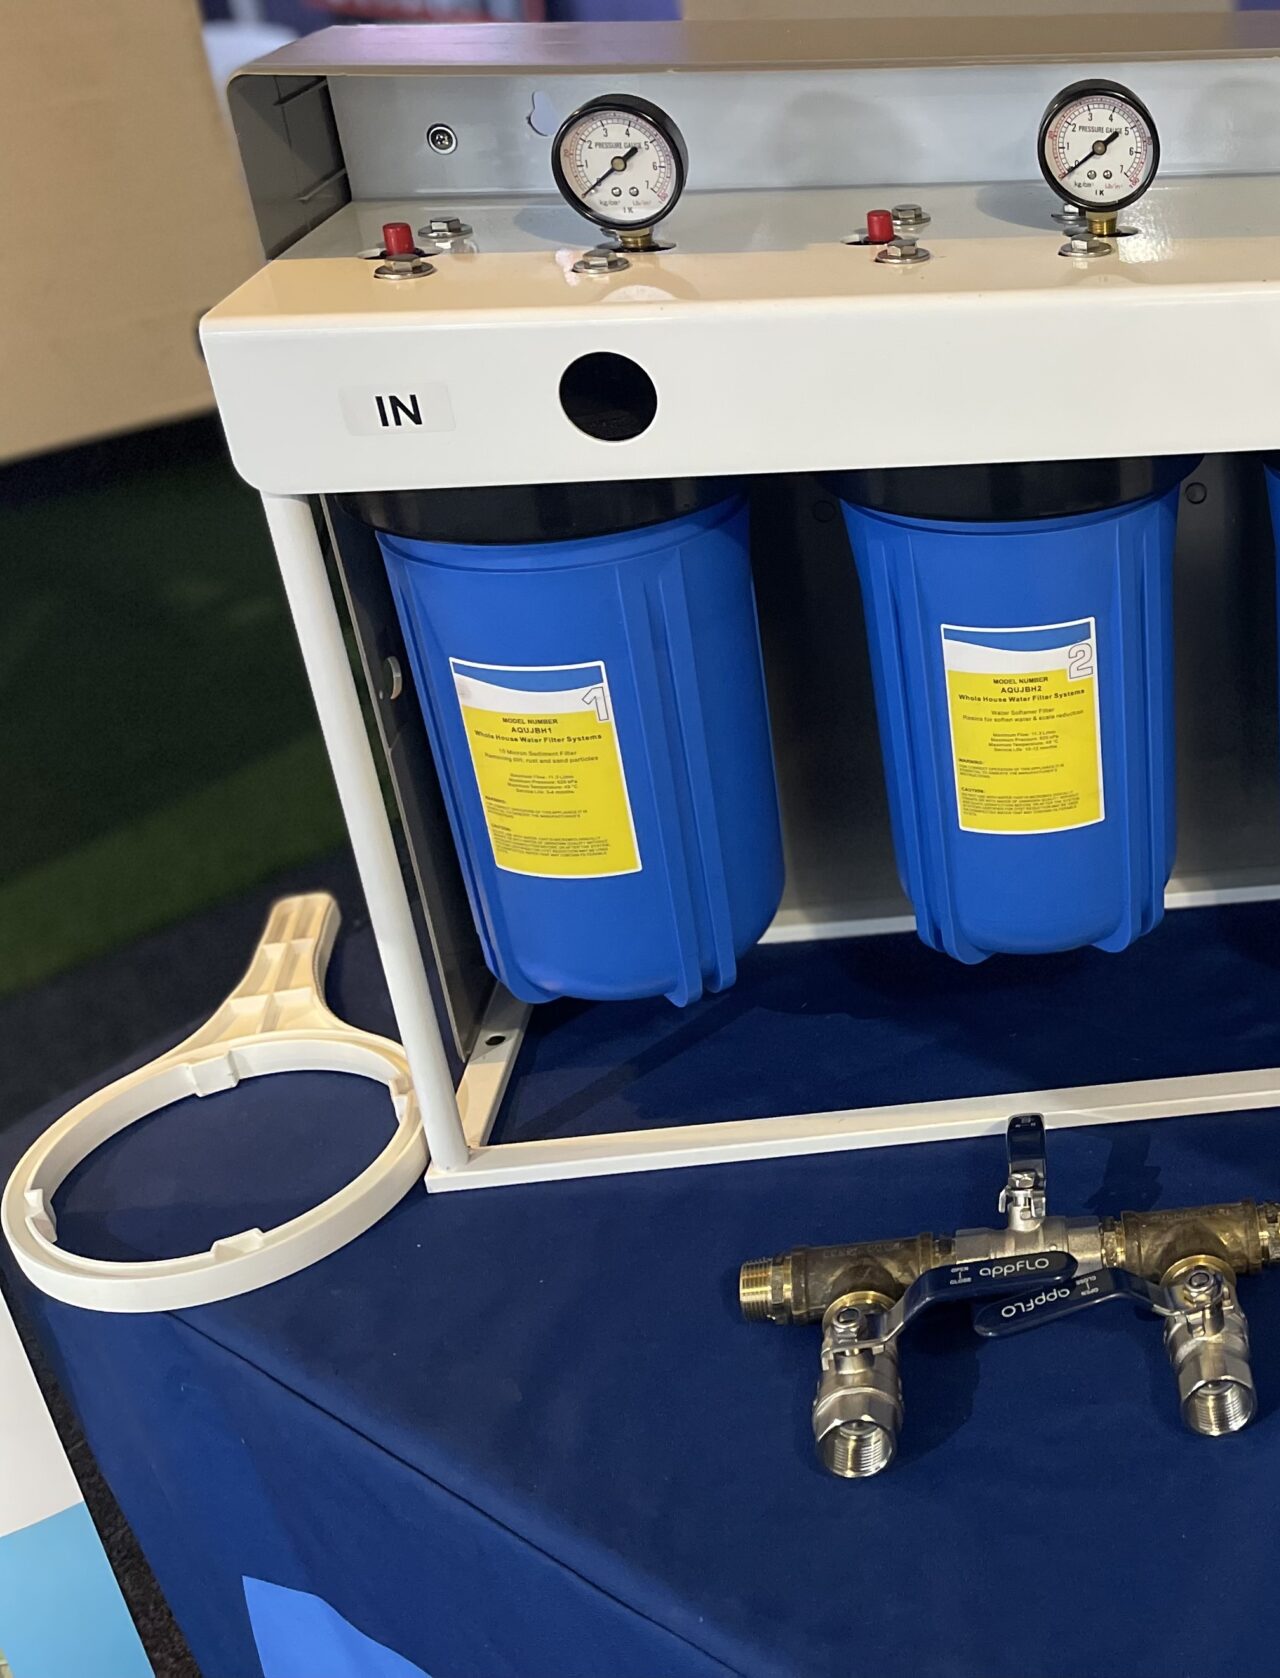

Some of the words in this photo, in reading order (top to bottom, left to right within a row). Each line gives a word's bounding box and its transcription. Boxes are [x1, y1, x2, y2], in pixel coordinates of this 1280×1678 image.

[1078, 125, 1105, 133] PRESSURE
[375, 395, 422, 428] IN
[1068, 642, 1094, 680] 2
[1019, 676, 1048, 684] NUMBER
[582, 686, 609, 722] 1
[958, 694, 981, 702] Whole
[983, 695, 1007, 703] House
[1008, 695, 1031, 703] Water
[1032, 693, 1052, 701] Filter
[1054, 688, 1085, 699] Systems
[502, 717, 526, 725] MODEL
[474, 730, 494, 739] Whole
[495, 734, 518, 742] House
[566, 734, 602, 743] Systems
[979, 1258, 1049, 1278] appFLO
[1001, 1288, 1070, 1317] appFLO
